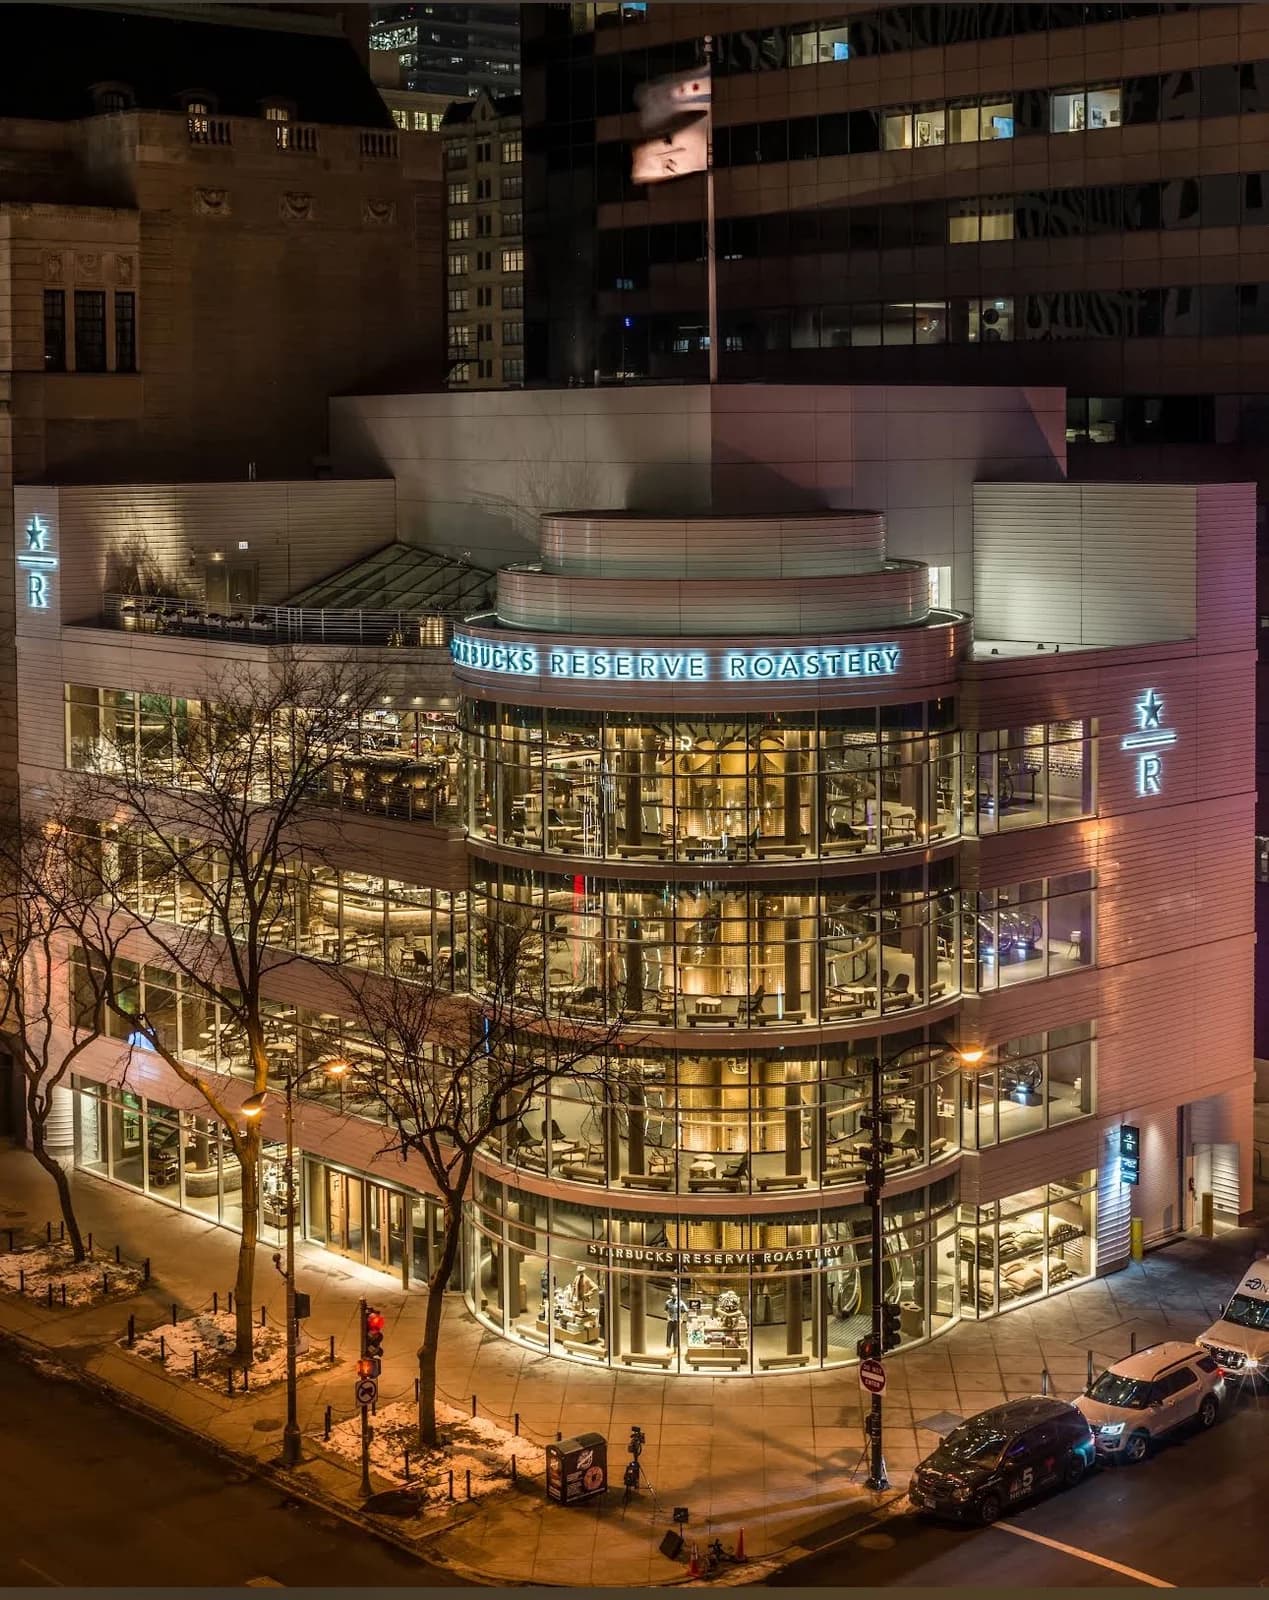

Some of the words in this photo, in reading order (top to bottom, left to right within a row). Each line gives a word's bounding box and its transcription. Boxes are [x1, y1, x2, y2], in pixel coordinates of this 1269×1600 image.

[28, 575, 43, 606] R
[450, 638, 534, 671] ARBUCKS
[551, 654, 704, 676] RESERVE
[730, 650, 899, 677] ROASTERY
[1142, 757, 1162, 792] R
[1023, 1467, 1033, 1487] 5
